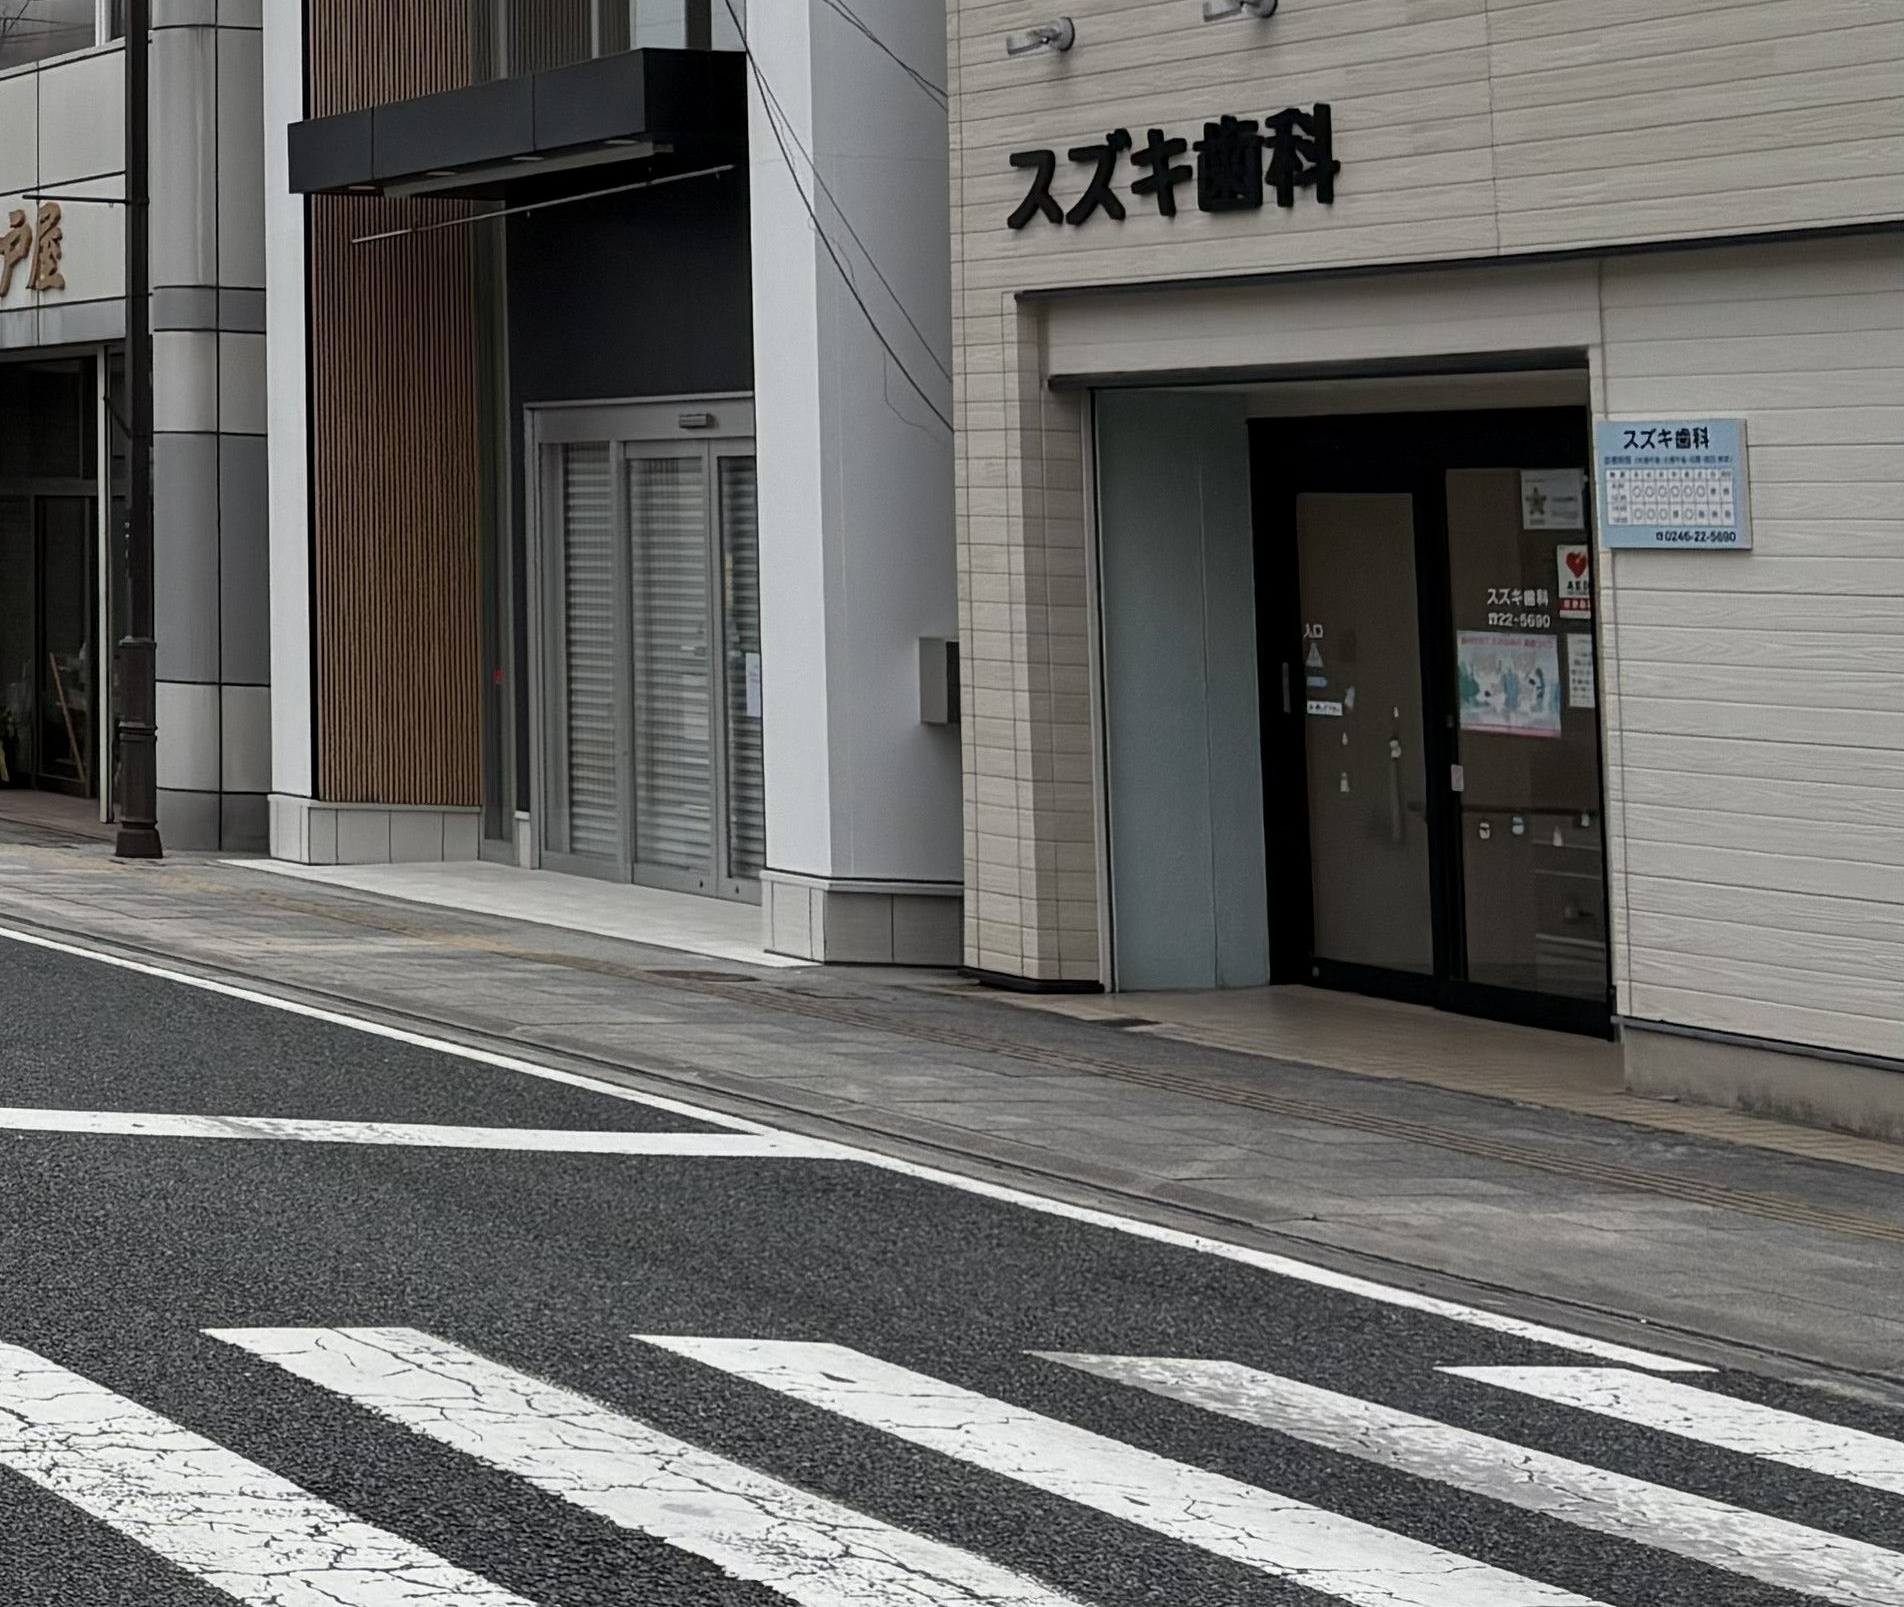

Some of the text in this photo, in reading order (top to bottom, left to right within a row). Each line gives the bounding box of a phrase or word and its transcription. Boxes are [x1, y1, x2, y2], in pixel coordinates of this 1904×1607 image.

[1007, 103, 1340, 230] スズキ歯科
[1623, 426, 1710, 450] スズキ歯科
[1303, 623, 1323, 638] 入口
